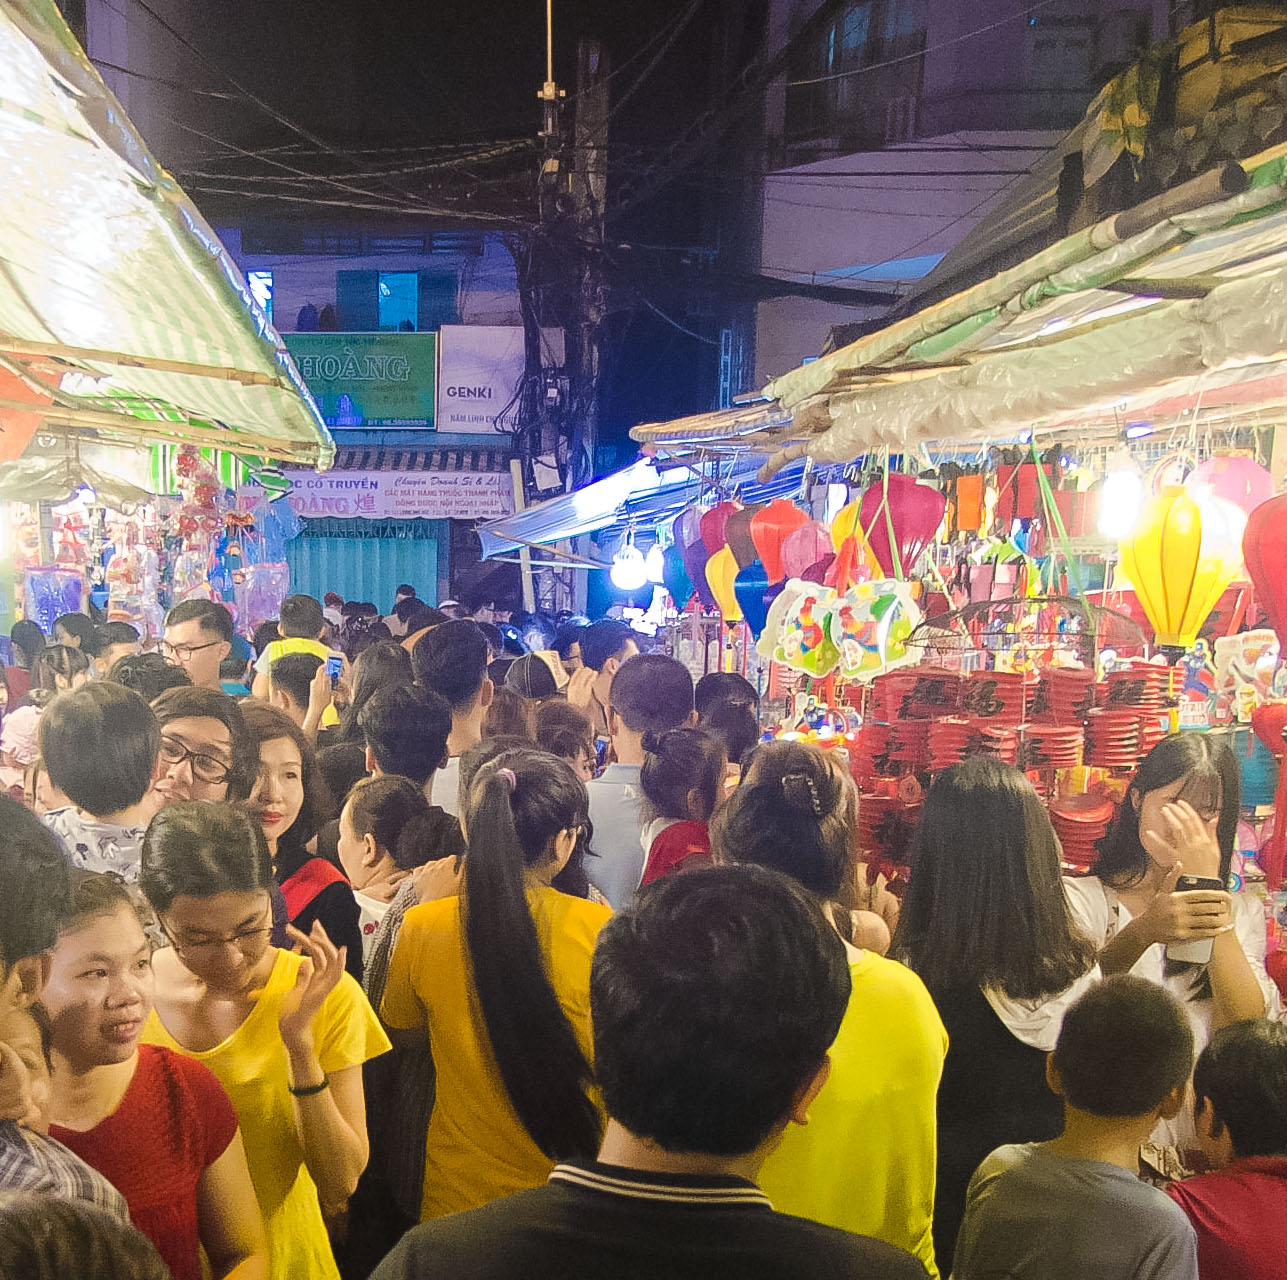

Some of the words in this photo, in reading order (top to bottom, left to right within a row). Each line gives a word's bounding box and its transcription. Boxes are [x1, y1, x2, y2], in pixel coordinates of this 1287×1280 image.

[295, 347, 411, 381] HOÀNG
[447, 387, 492, 398] GENKI
[329, 477, 379, 489] TRUYỀN
[289, 493, 350, 515] OÀNG
